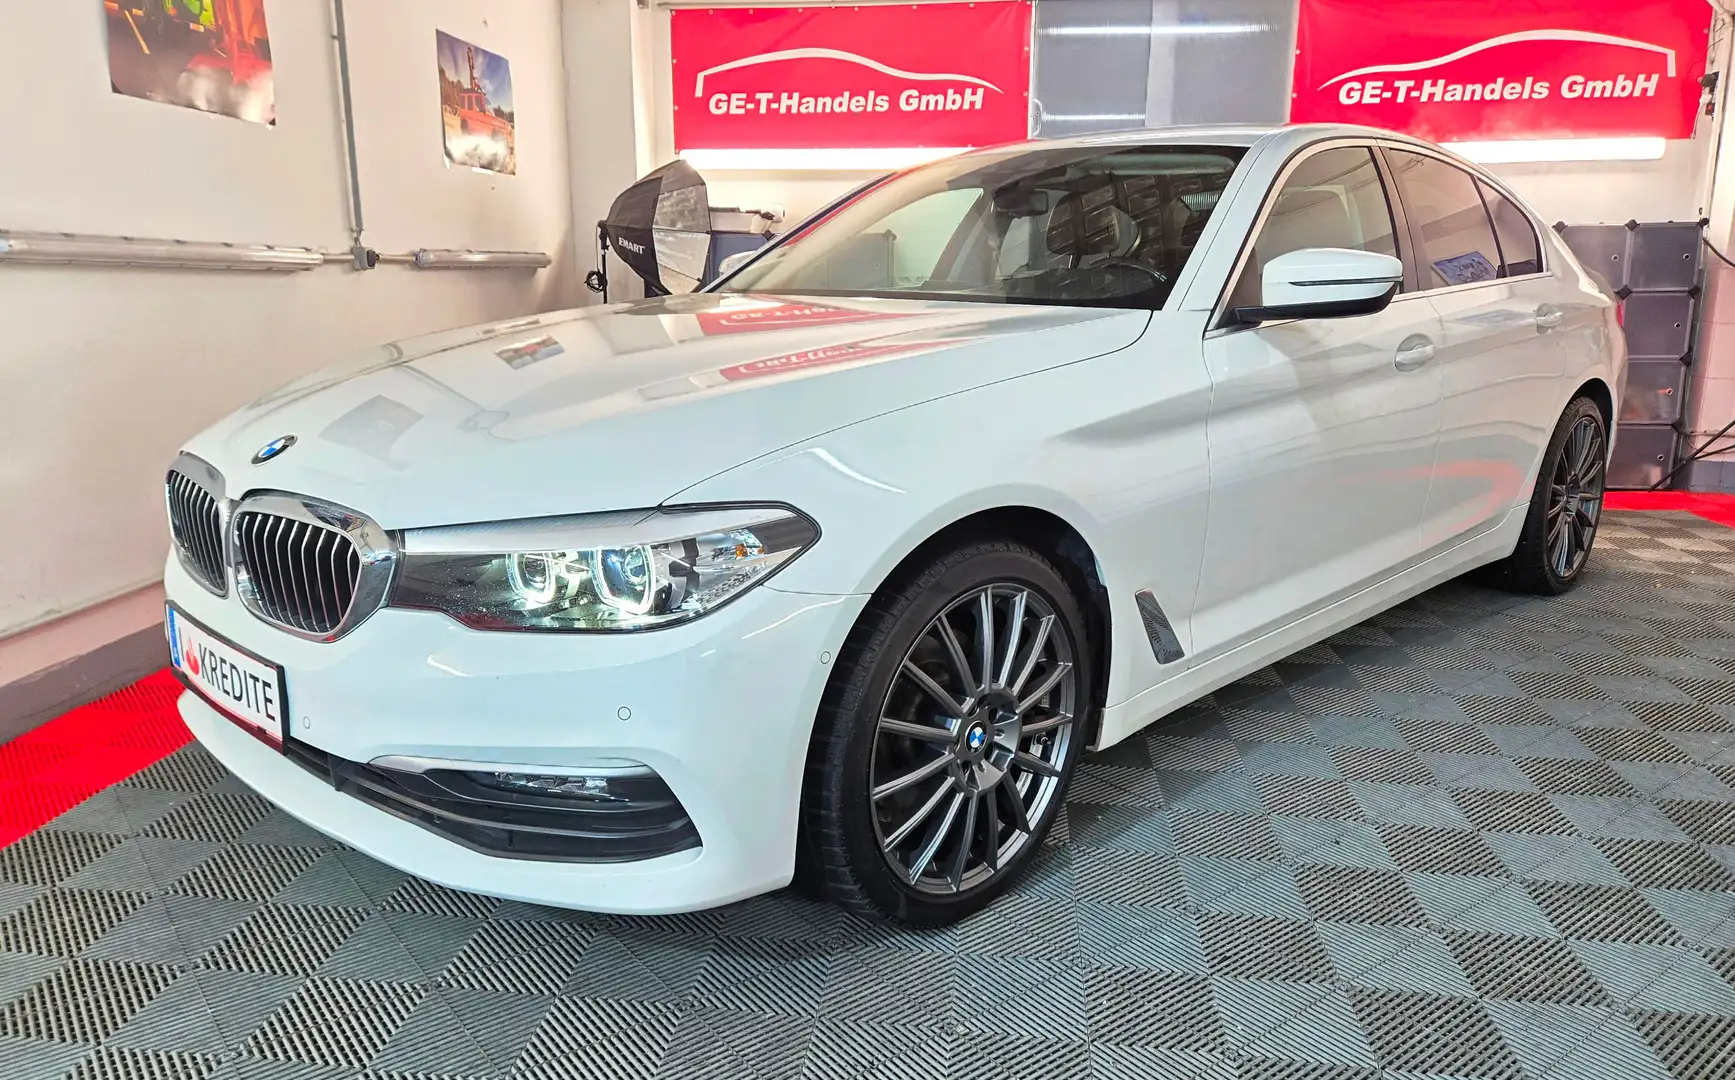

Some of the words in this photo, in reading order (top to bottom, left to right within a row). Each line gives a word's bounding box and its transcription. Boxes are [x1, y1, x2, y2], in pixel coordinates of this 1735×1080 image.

[709, 91, 889, 115] GE-T-Handels
[899, 88, 984, 111] GmbH
[1339, 77, 1549, 105] GE-T-Handels
[1560, 74, 1659, 98] GmbH
[618, 236, 644, 255] EMART
[199, 643, 276, 721] KREDITE
